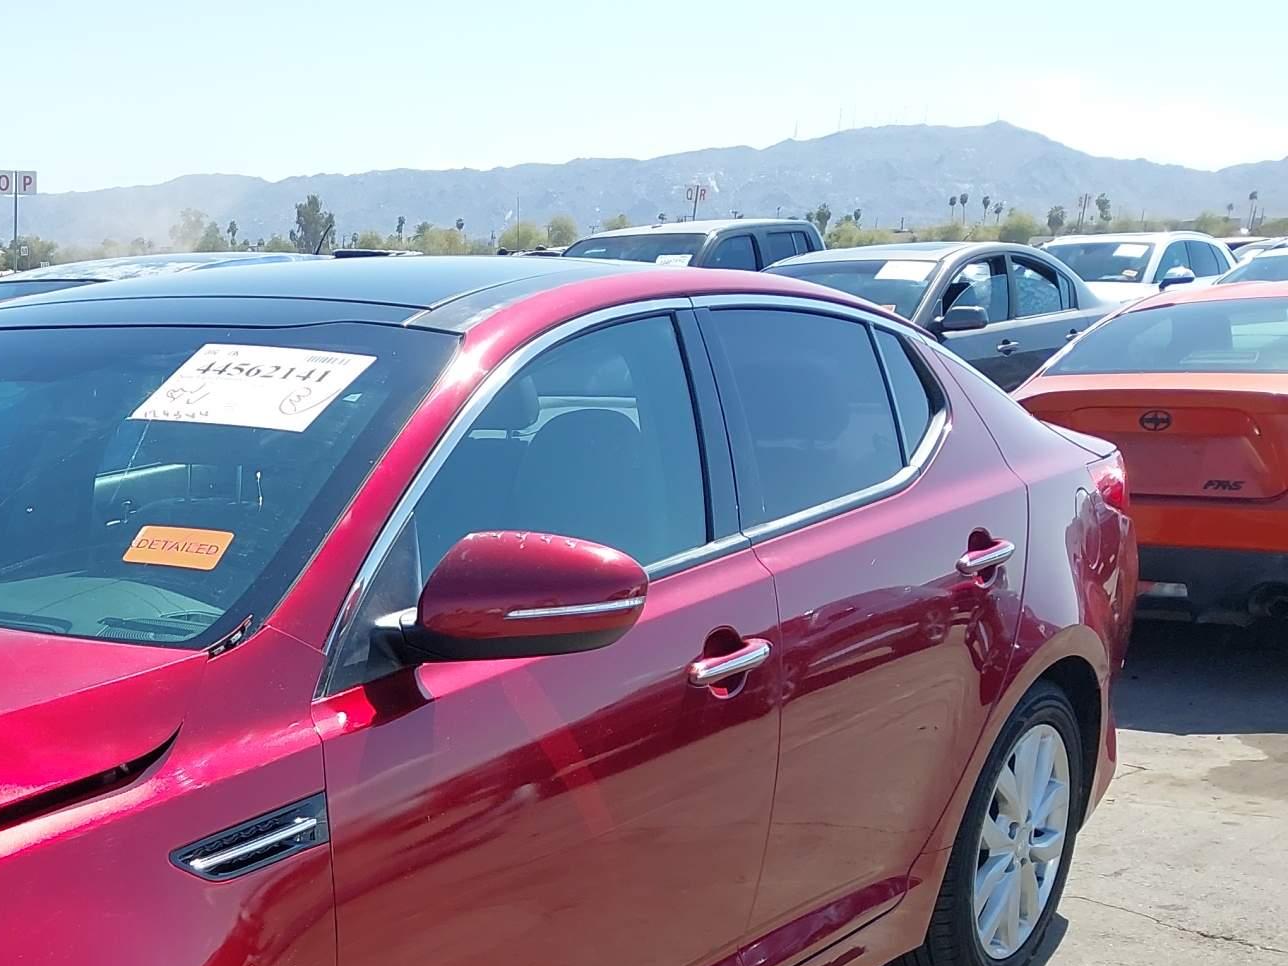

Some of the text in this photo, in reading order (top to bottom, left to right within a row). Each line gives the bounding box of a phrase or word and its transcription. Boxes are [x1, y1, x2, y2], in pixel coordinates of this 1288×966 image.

[23, 176, 32, 191] P
[699, 189, 706, 200] R
[196, 361, 332, 383] 44562141
[136, 537, 221, 556] DETAILED
